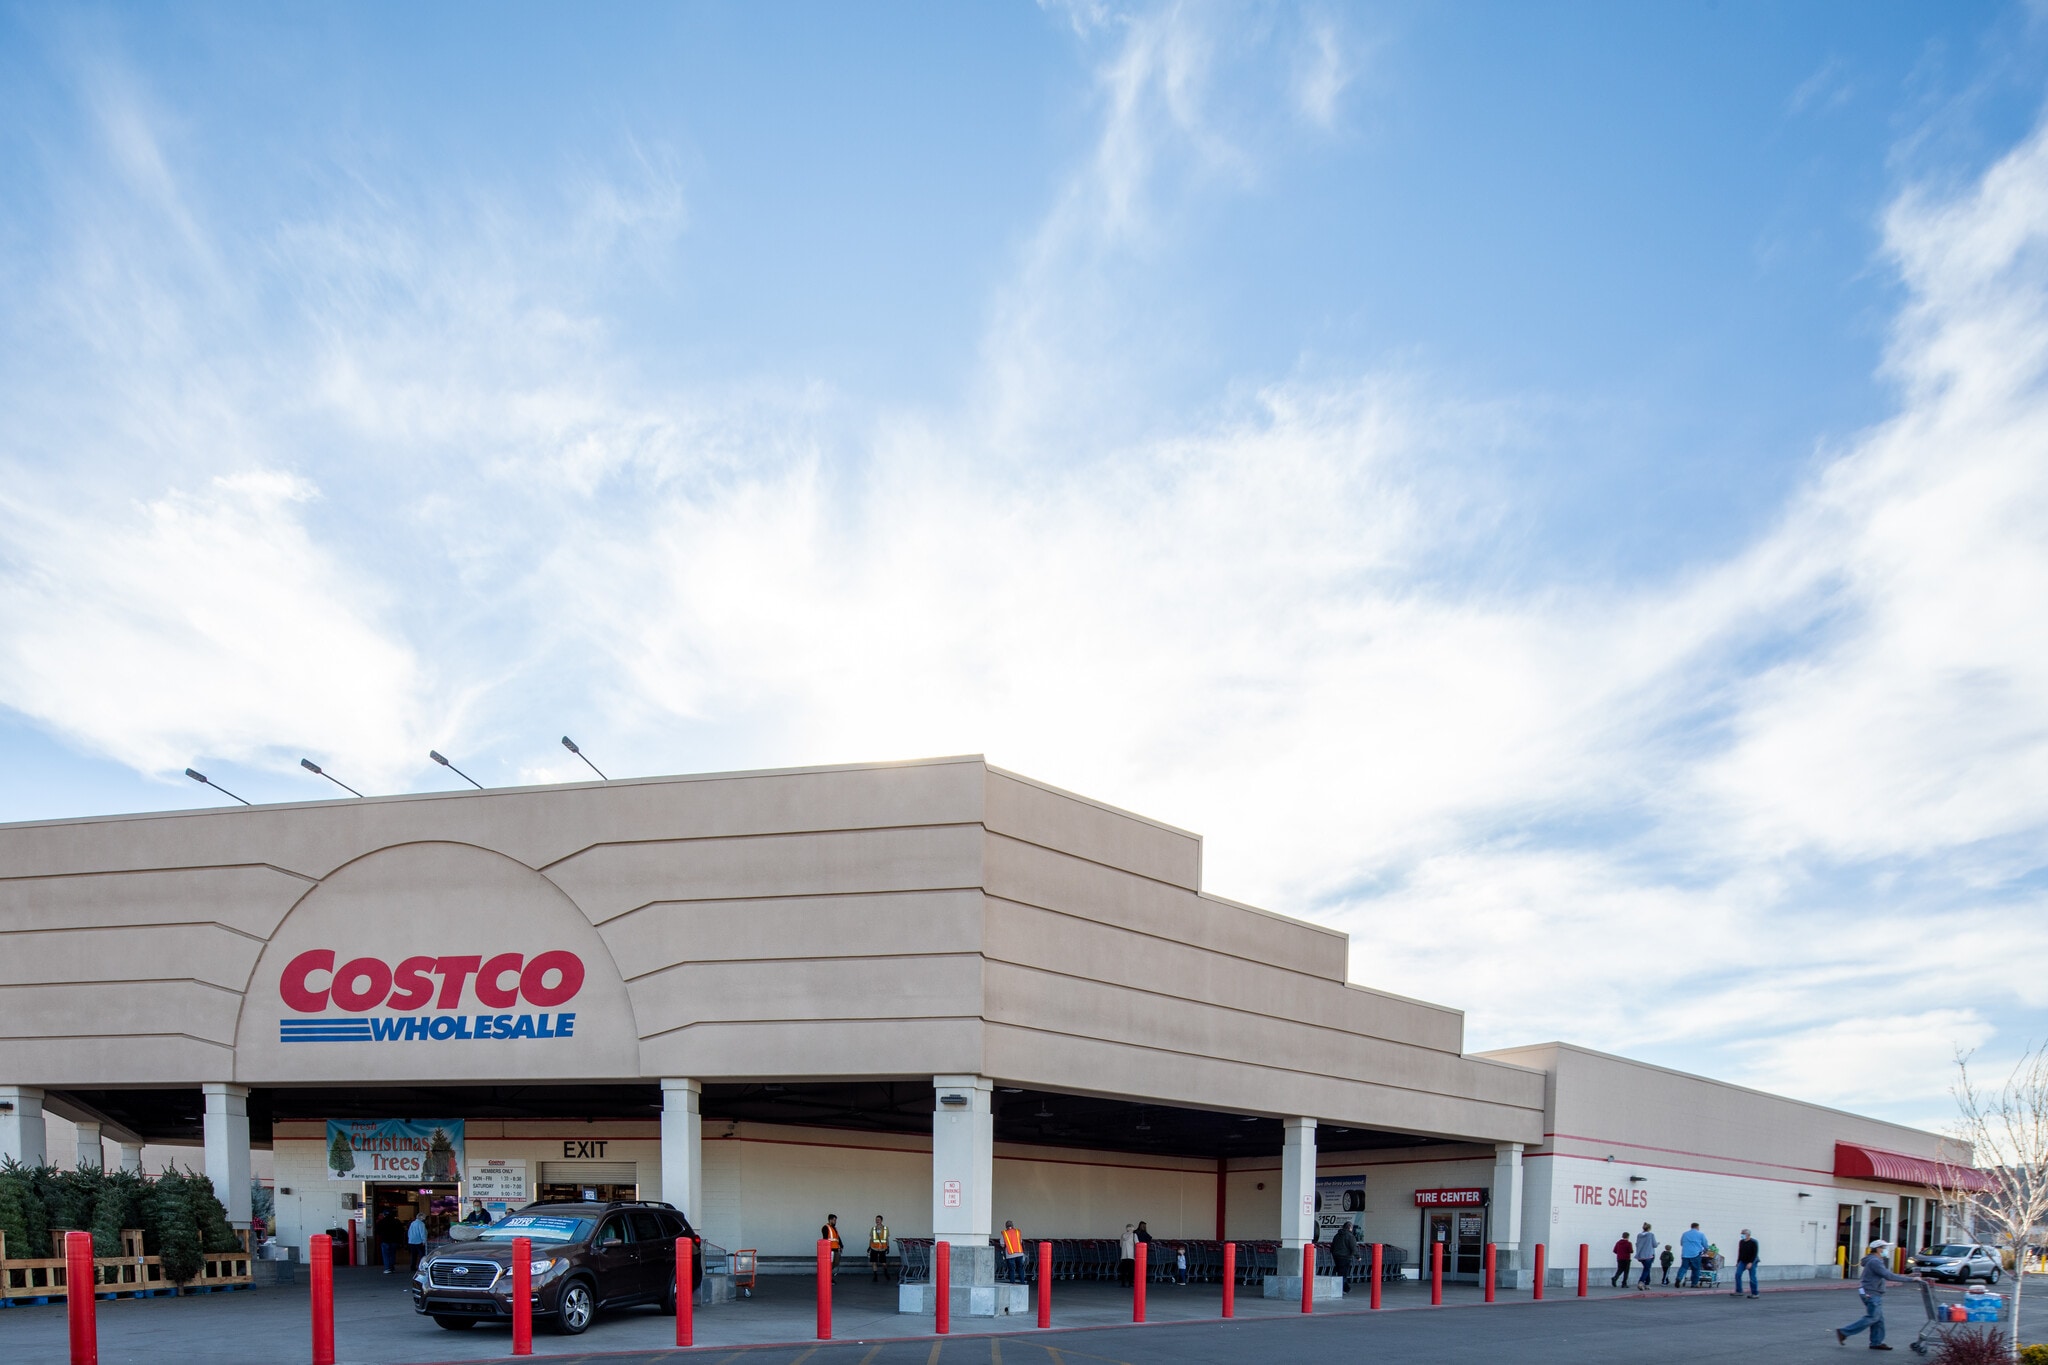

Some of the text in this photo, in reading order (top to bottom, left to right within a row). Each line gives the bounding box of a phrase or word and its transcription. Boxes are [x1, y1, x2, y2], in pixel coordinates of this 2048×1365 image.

[280, 949, 585, 1012] COSTCO
[370, 1013, 576, 1041] WHOLESALE
[351, 1121, 377, 1131] Fresh
[350, 1132, 431, 1152] Christmas
[563, 1141, 608, 1158] EXIT
[371, 1153, 420, 1171] Trees
[1416, 1191, 1480, 1203] TIRE CENTER
[1574, 1185, 1647, 1208] TIRE SALES
[1318, 1215, 1336, 1225] $150
